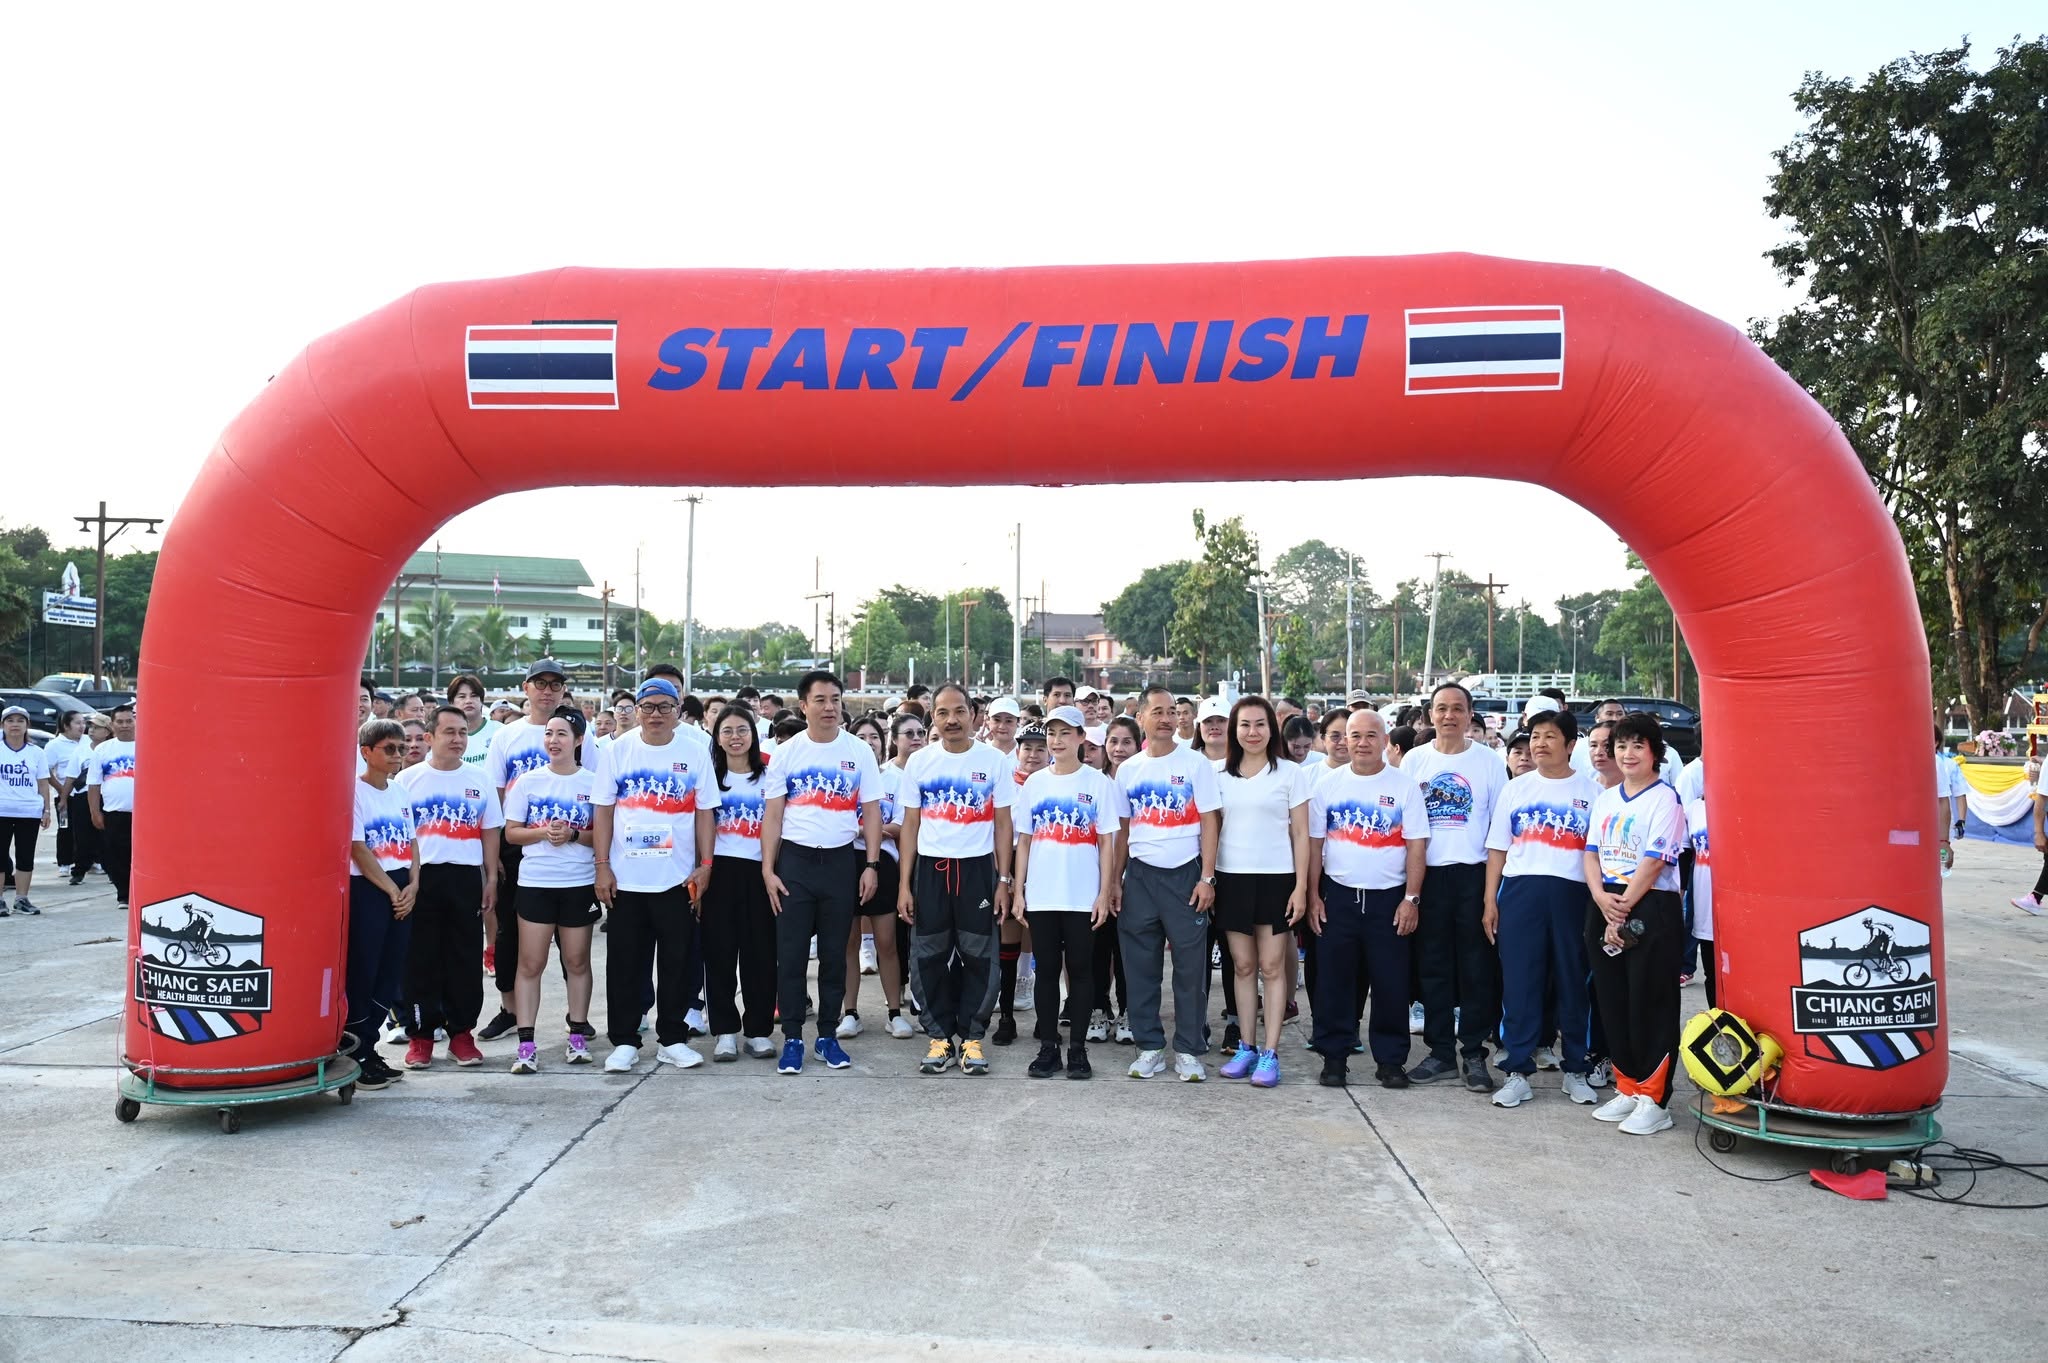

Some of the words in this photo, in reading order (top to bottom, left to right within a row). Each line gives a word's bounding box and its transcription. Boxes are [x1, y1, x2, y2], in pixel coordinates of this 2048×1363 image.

[646, 314, 1370, 401] START/FINISH
[642, 835, 661, 843] 829
[143, 968, 199, 991] CHIANG
[206, 977, 258, 993] SAEN
[157, 989, 185, 1001] HEALTH
[187, 994, 206, 1003] BIKE
[208, 995, 232, 1005] CLUB
[1806, 996, 1886, 1013] CHIANG
[1892, 991, 1931, 1011] SAEN
[1836, 1015, 1872, 1027] HEALTH
[1874, 1015, 1894, 1025] BIKE
[1895, 1013, 1915, 1024] CLUB
